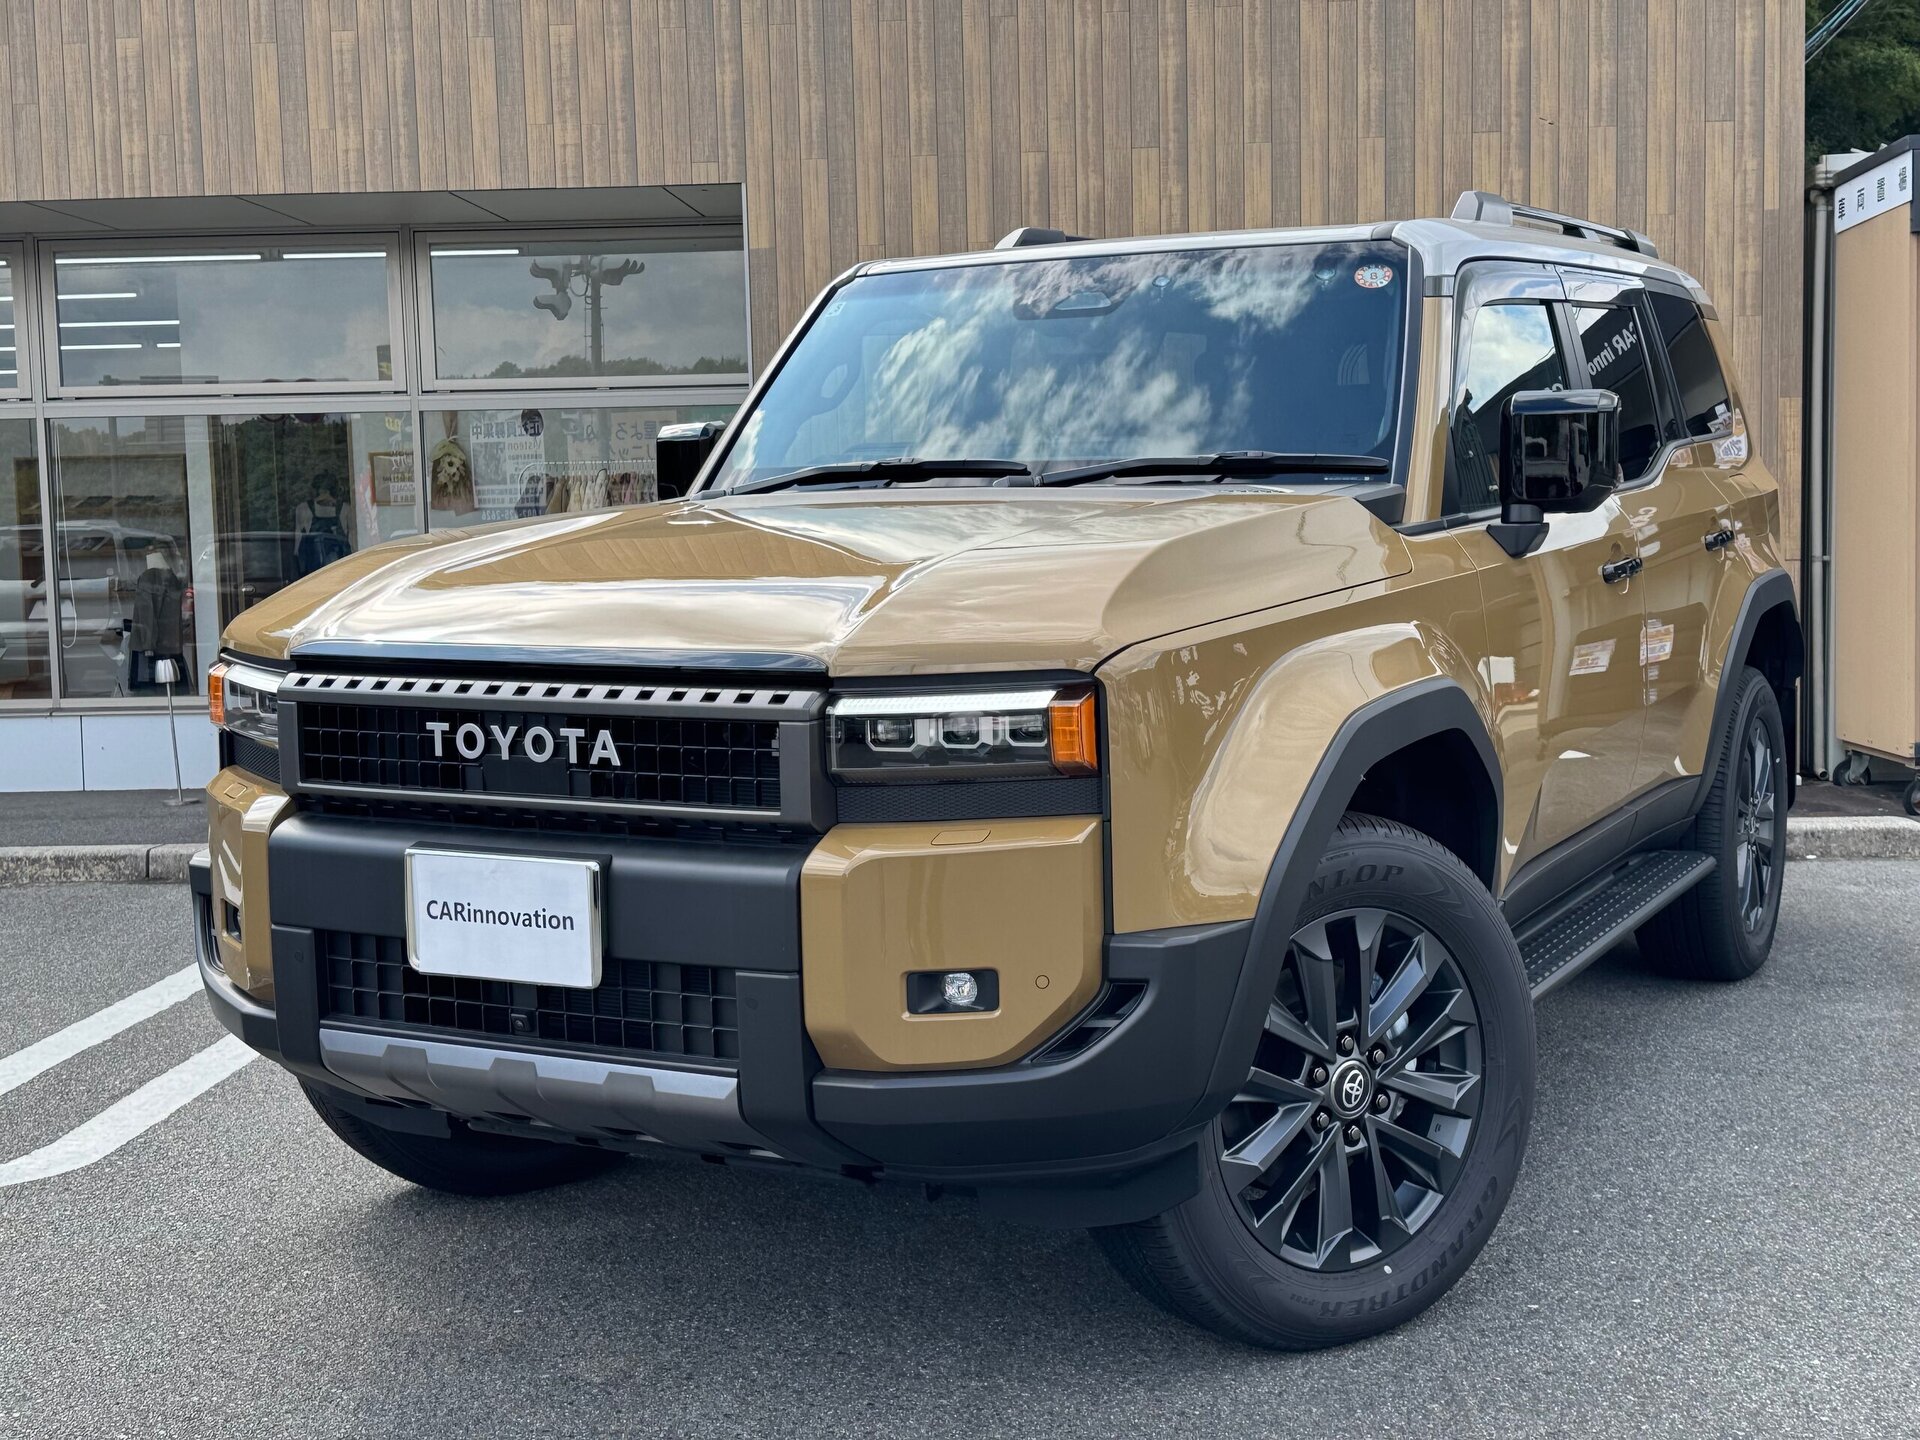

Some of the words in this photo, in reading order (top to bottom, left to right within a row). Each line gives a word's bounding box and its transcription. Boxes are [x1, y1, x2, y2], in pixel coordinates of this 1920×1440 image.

[426, 722, 621, 767] TOYOTA
[1307, 864, 1405, 898] NLOP
[426, 899, 575, 931] CARinnovation
[1318, 1176, 1498, 1319] GRANDTREK
